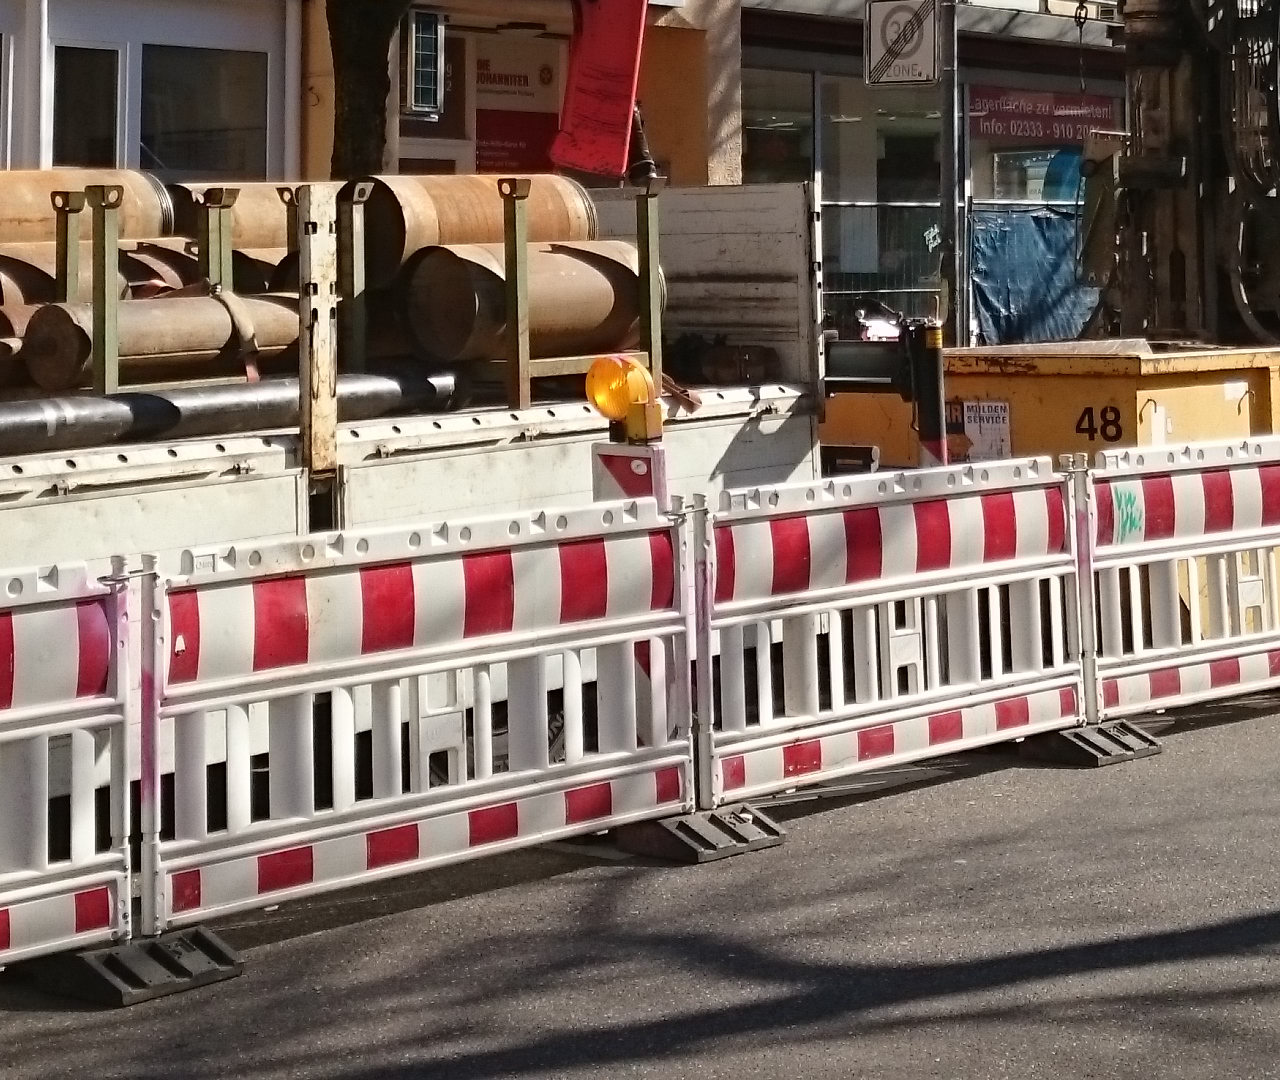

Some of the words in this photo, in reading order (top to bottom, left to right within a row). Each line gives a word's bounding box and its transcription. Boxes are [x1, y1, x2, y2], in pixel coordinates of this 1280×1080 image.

[885, 63, 919, 78] ZONE
[1036, 103, 1050, 115] zu
[979, 118, 1007, 135] Info:
[1010, 120, 1043, 138] 02333
[1052, 123, 1073, 140] 910
[966, 404, 1008, 414] MULDEN
[967, 415, 1008, 425] SERVICE
[1075, 405, 1123, 443] 48
